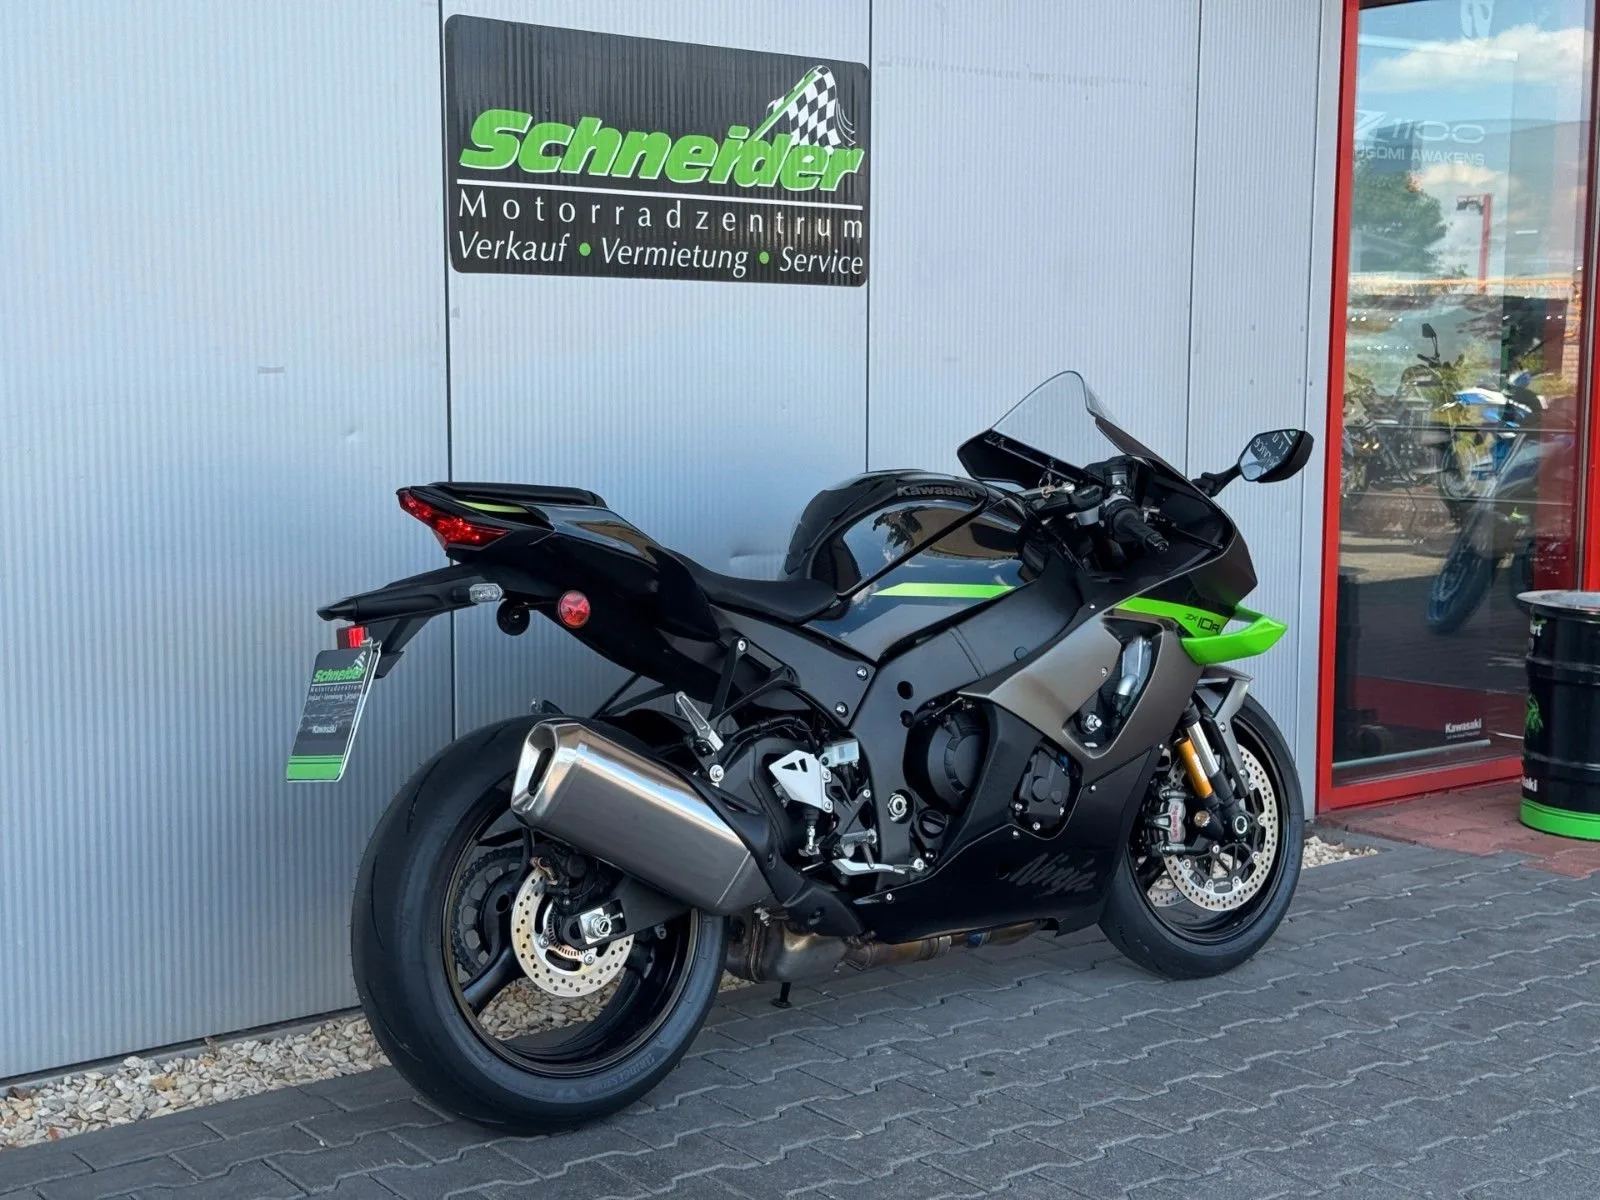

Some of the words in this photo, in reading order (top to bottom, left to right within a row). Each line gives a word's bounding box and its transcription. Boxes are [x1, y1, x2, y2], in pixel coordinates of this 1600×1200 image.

[458, 109, 865, 192] Schneider
[1411, 149, 1485, 166] AWAKENS
[458, 190, 863, 239] Motorradzentrum
[458, 231, 570, 263] Verkauf
[601, 238, 748, 279] Vermietung
[779, 246, 864, 275] Service
[896, 485, 977, 498] Kawasaki
[313, 667, 365, 683] Schneider
[1445, 718, 1482, 734] Kawasaki
